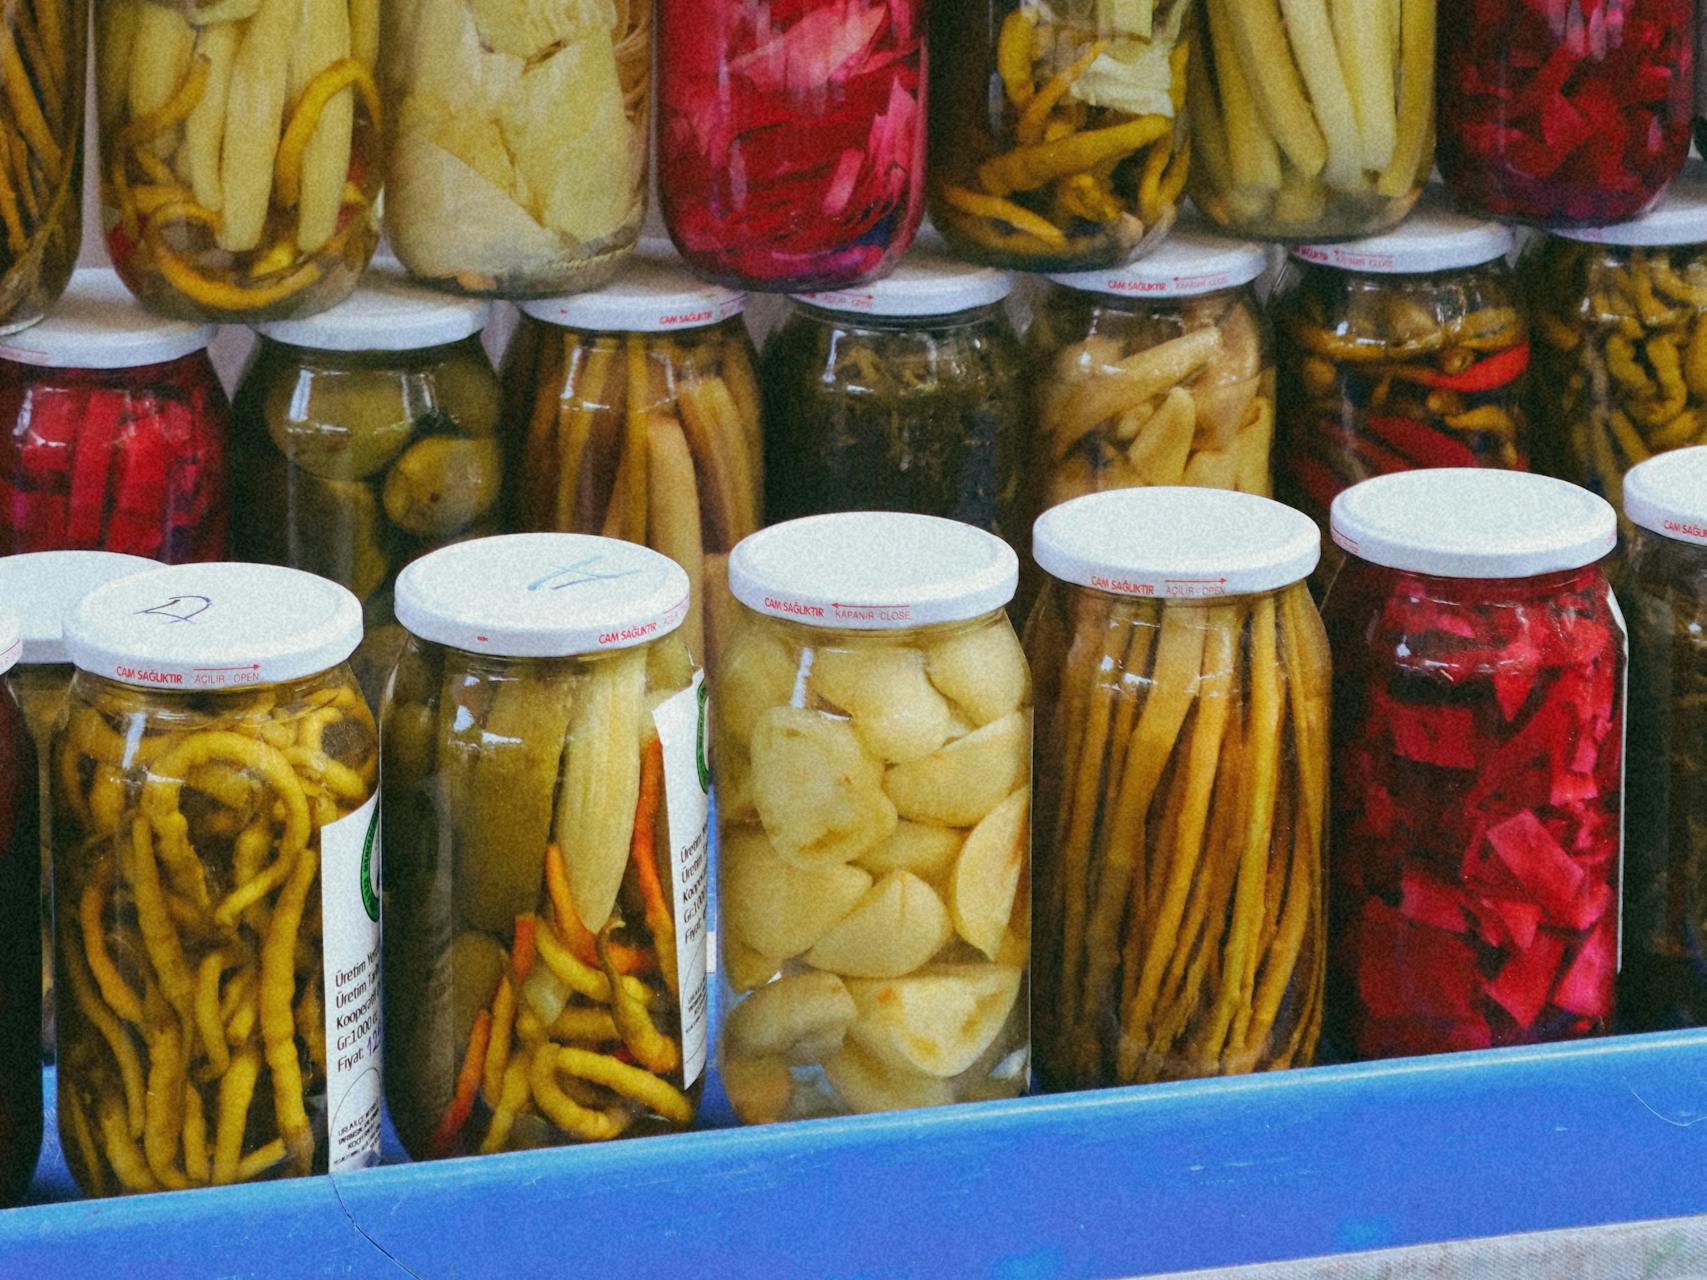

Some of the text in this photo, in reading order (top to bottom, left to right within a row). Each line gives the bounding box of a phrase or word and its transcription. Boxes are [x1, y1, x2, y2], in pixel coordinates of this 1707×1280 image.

[1108, 280, 1125, 289] CAM
[660, 314, 678, 324] CAM
[1664, 520, 1680, 532] CAM
[1091, 576, 1108, 587] CAM
[764, 596, 911, 620] CAM SAĞLIKTIR KAPANIR CLOSE
[598, 632, 620, 644] CAM
[116, 666, 260, 685] CAM SAĞLIKTIR AÇILIR OPEN
[335, 960, 366, 988] Üretim
[336, 982, 367, 1009] Üretim
[338, 1048, 364, 1072] Fiyat:
